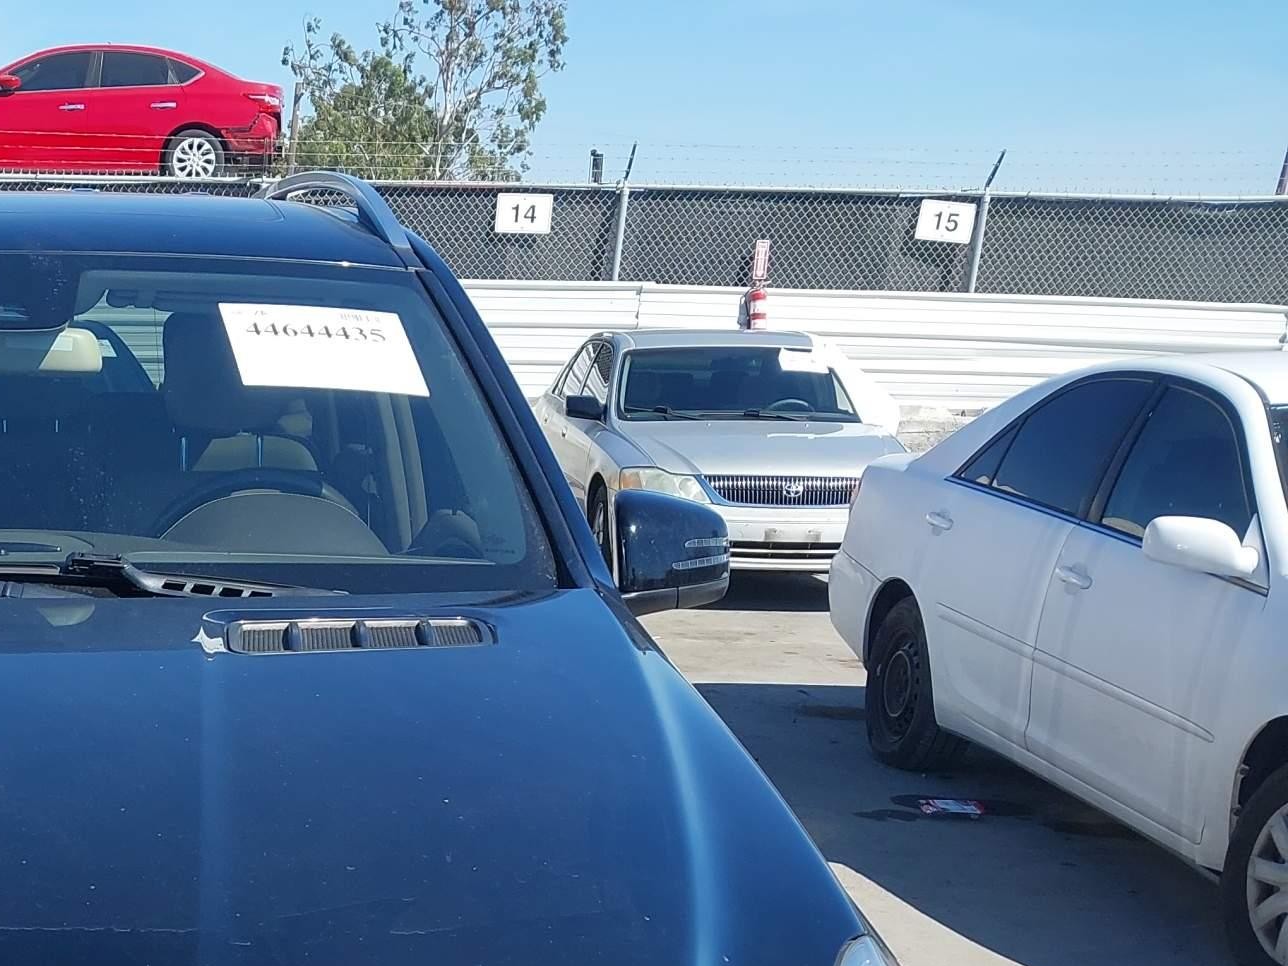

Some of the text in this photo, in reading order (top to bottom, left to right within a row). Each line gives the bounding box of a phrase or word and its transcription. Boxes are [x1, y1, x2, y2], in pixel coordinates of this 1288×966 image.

[512, 203, 537, 224] 14
[933, 211, 960, 232] 15
[245, 322, 386, 343] 44644435
